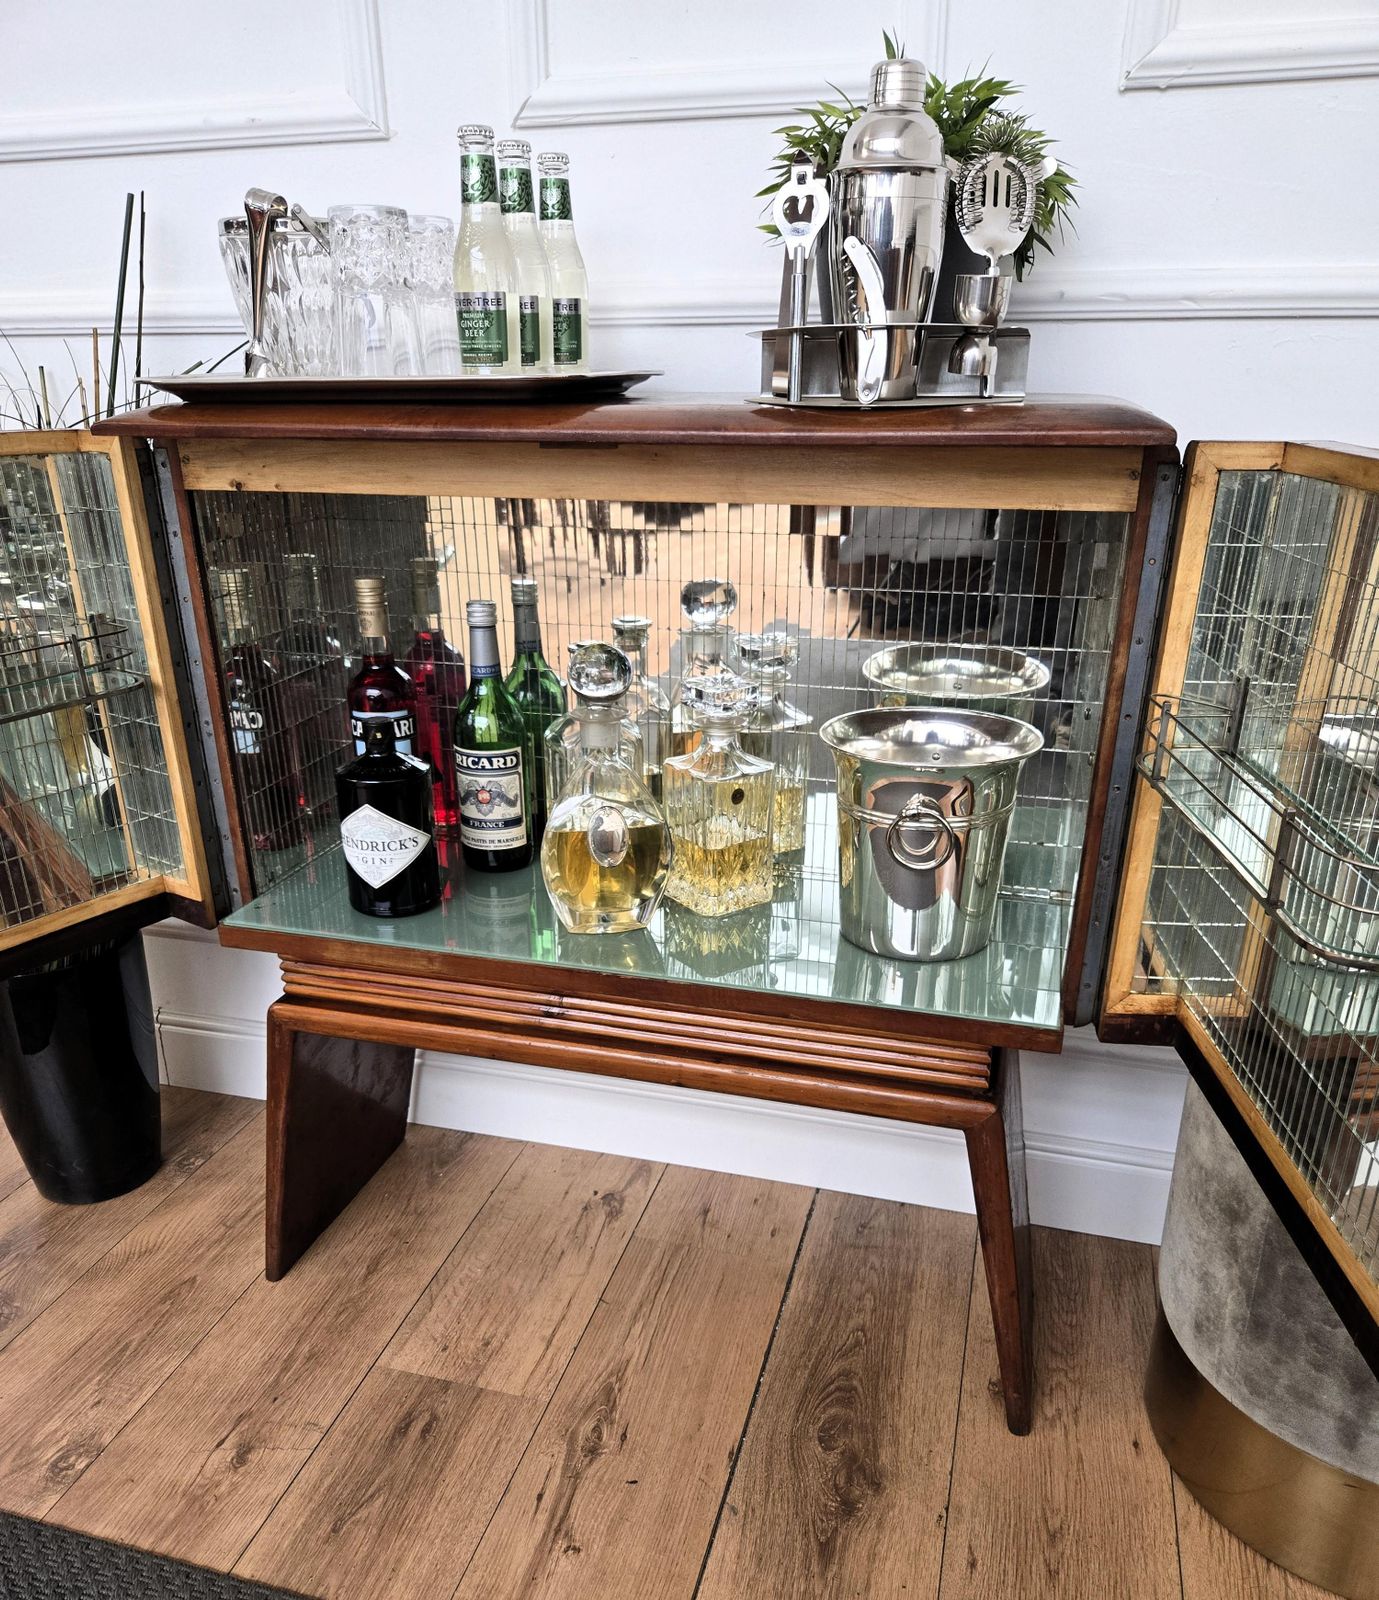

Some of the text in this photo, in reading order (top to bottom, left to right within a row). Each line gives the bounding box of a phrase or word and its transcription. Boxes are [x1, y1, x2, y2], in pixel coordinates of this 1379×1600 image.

[460, 320, 490, 328] GINGER
[464, 329, 485, 337] BEER
[455, 753, 517, 770] RICARD
[469, 820, 505, 828] FRANCE
[361, 856, 387, 865] GIN
